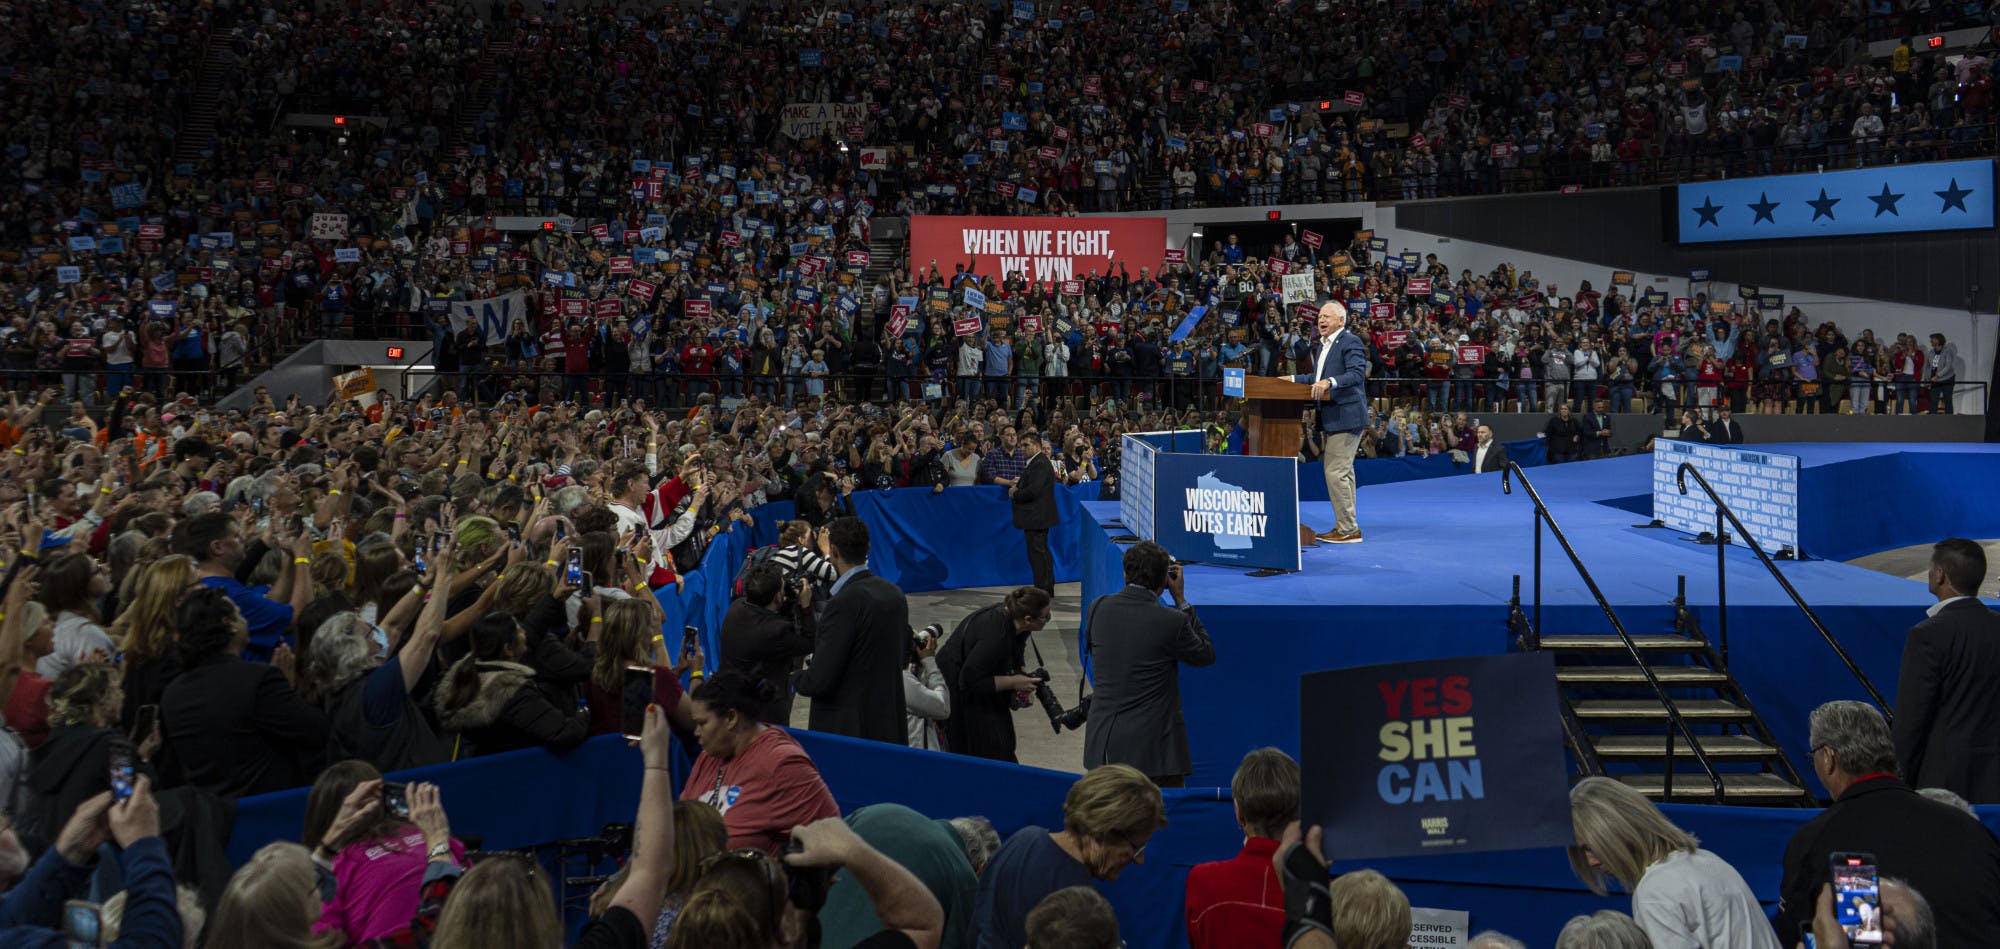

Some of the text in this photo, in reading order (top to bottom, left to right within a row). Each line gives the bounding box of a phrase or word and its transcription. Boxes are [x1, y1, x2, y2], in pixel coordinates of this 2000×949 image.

[1928, 36, 1942, 46] EXIT
[783, 104, 862, 118] MAKE A PLAN
[1321, 101, 1330, 109] EXIT
[790, 122, 821, 137] VOTE
[632, 181, 662, 199] VTE
[962, 229, 1114, 260] WHEN WE FIGHT,
[1000, 256, 1072, 282] WE WIN
[1239, 281, 1253, 292] 80
[388, 348, 401, 358] EXIT
[1186, 488, 1264, 514] WISCONSIN
[1183, 510, 1268, 537] VOTES EARLY
[1377, 675, 1473, 718] YES
[1378, 716, 1477, 762] SHE
[1376, 758, 1485, 805] CAN
[1421, 817, 1448, 829] HARRIS
[1414, 924, 1452, 932] SERVED
[1410, 935, 1456, 944] CESSIBLE
